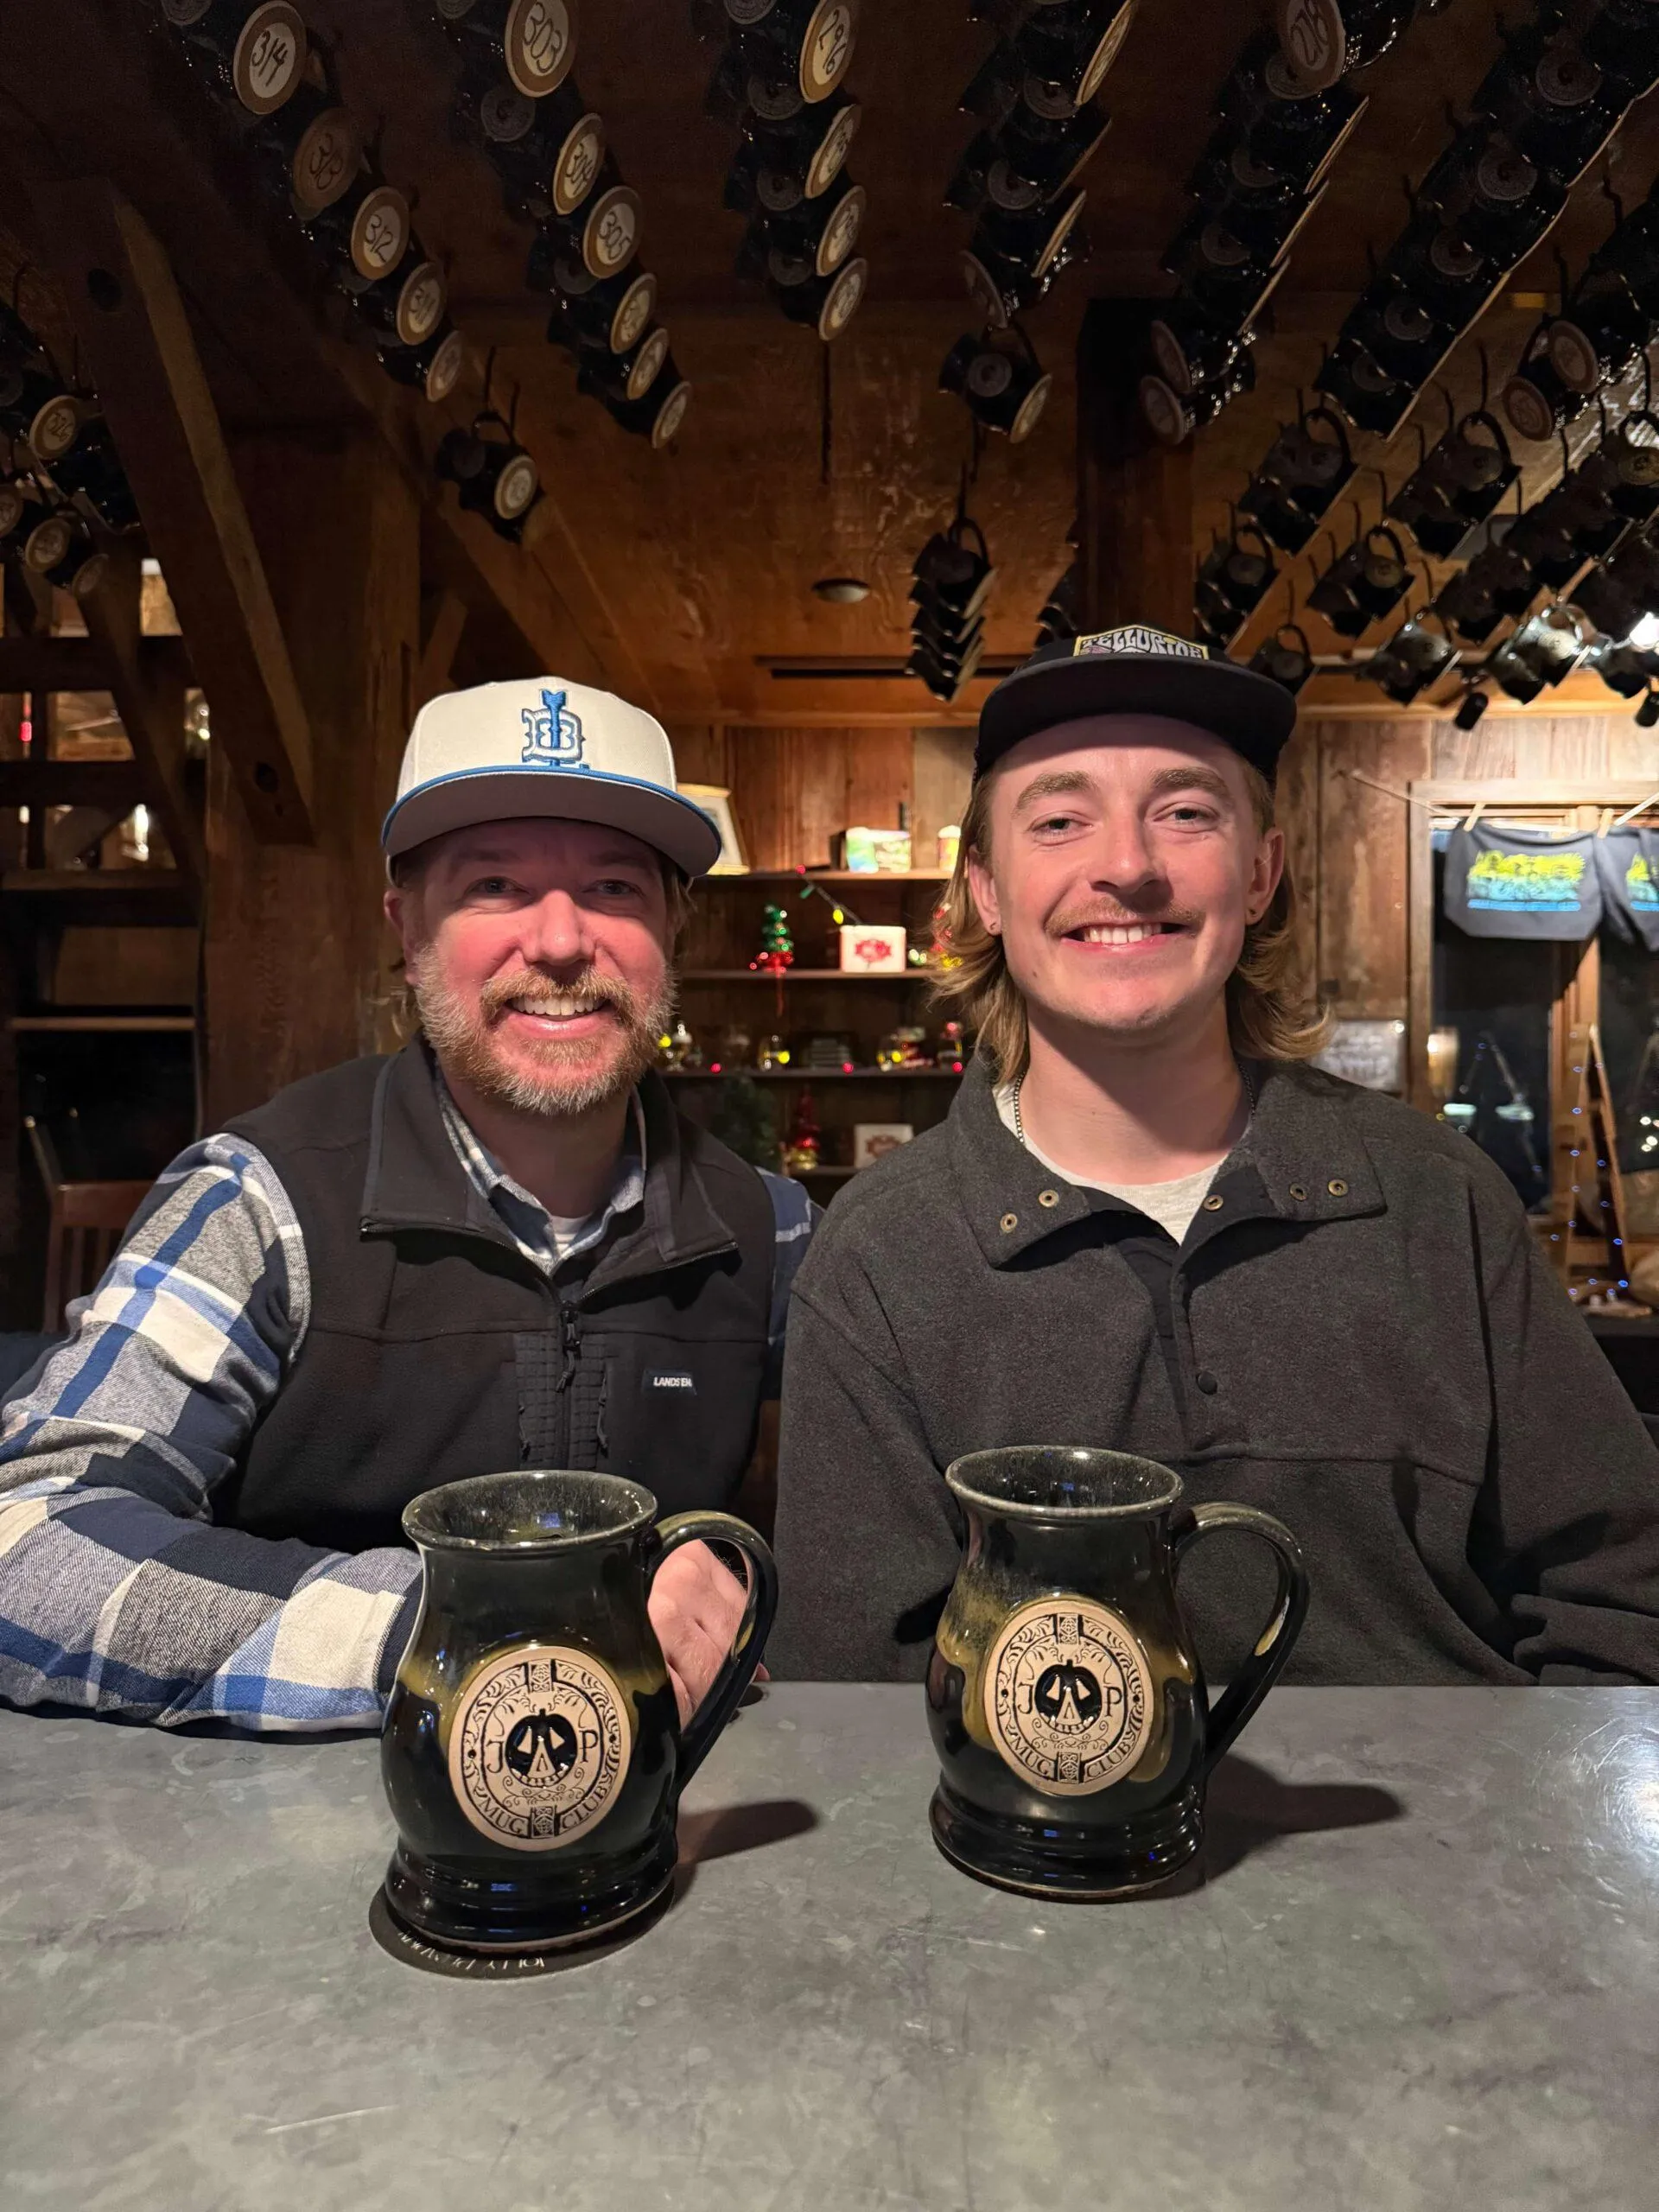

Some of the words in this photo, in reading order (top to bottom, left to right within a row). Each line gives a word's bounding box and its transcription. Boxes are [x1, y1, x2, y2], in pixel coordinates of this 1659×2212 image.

[251, 30, 289, 87] 314
[524, 2, 562, 73] 303
[365, 214, 394, 263] 312
[599, 212, 632, 260] 305
[1010, 1738, 1050, 1775] MUG
[1087, 1741, 1132, 1777] CLUB
[480, 1797, 524, 1834] MUG
[563, 1787, 607, 1829] CLUB
